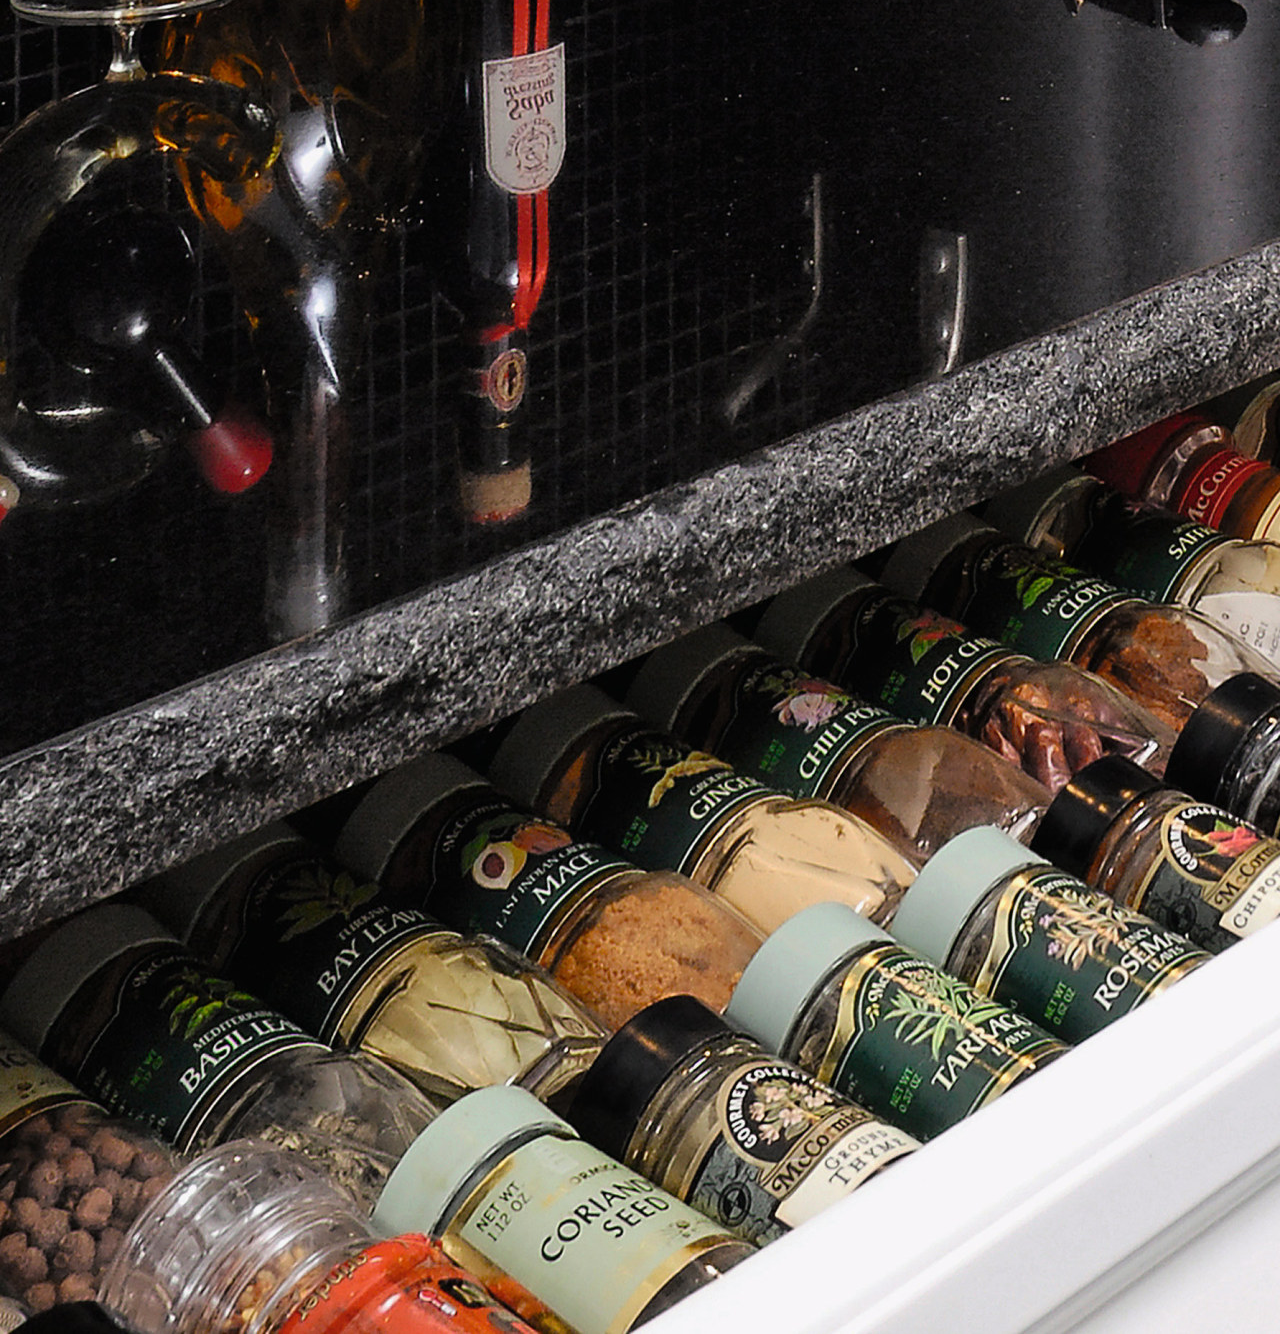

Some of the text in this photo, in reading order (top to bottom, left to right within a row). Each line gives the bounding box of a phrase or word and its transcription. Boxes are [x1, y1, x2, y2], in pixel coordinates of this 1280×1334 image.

[920, 654, 960, 705] HOT
[799, 722, 847, 780] CHILI
[531, 851, 600, 906] MACE
[316, 938, 361, 996] BAY
[178, 1029, 254, 1095] BASIL
[729, 1081, 758, 1149] GOURMET
[824, 1129, 889, 1170] GROUND
[475, 1180, 521, 1232] NET WT
[510, 1193, 532, 1213] OZ
[602, 1194, 672, 1239] SEED
[299, 1251, 369, 1322] grinder
